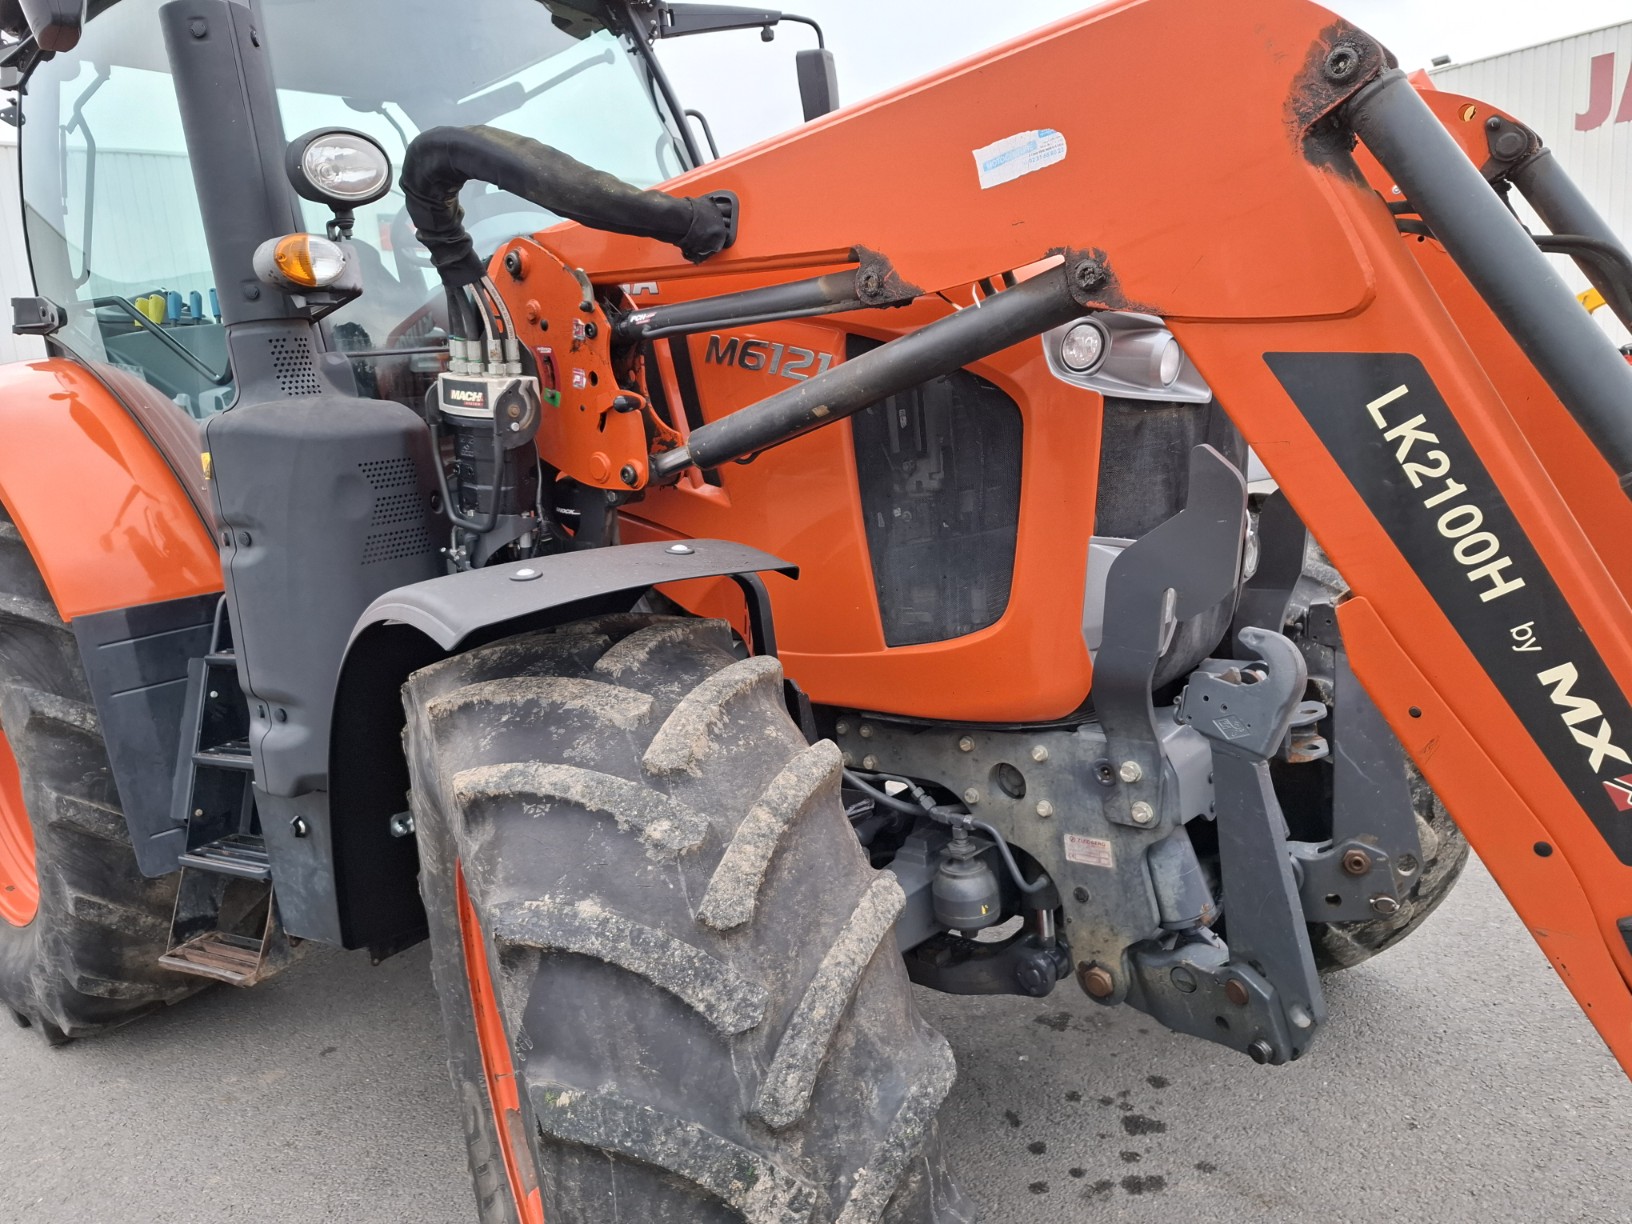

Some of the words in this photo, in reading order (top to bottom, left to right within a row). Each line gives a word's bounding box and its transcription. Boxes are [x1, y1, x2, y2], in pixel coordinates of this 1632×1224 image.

[705, 334, 832, 380] M6121
[1366, 384, 1526, 603] LK2100H
[1509, 621, 1543, 651] by
[1536, 661, 1632, 774] MX
